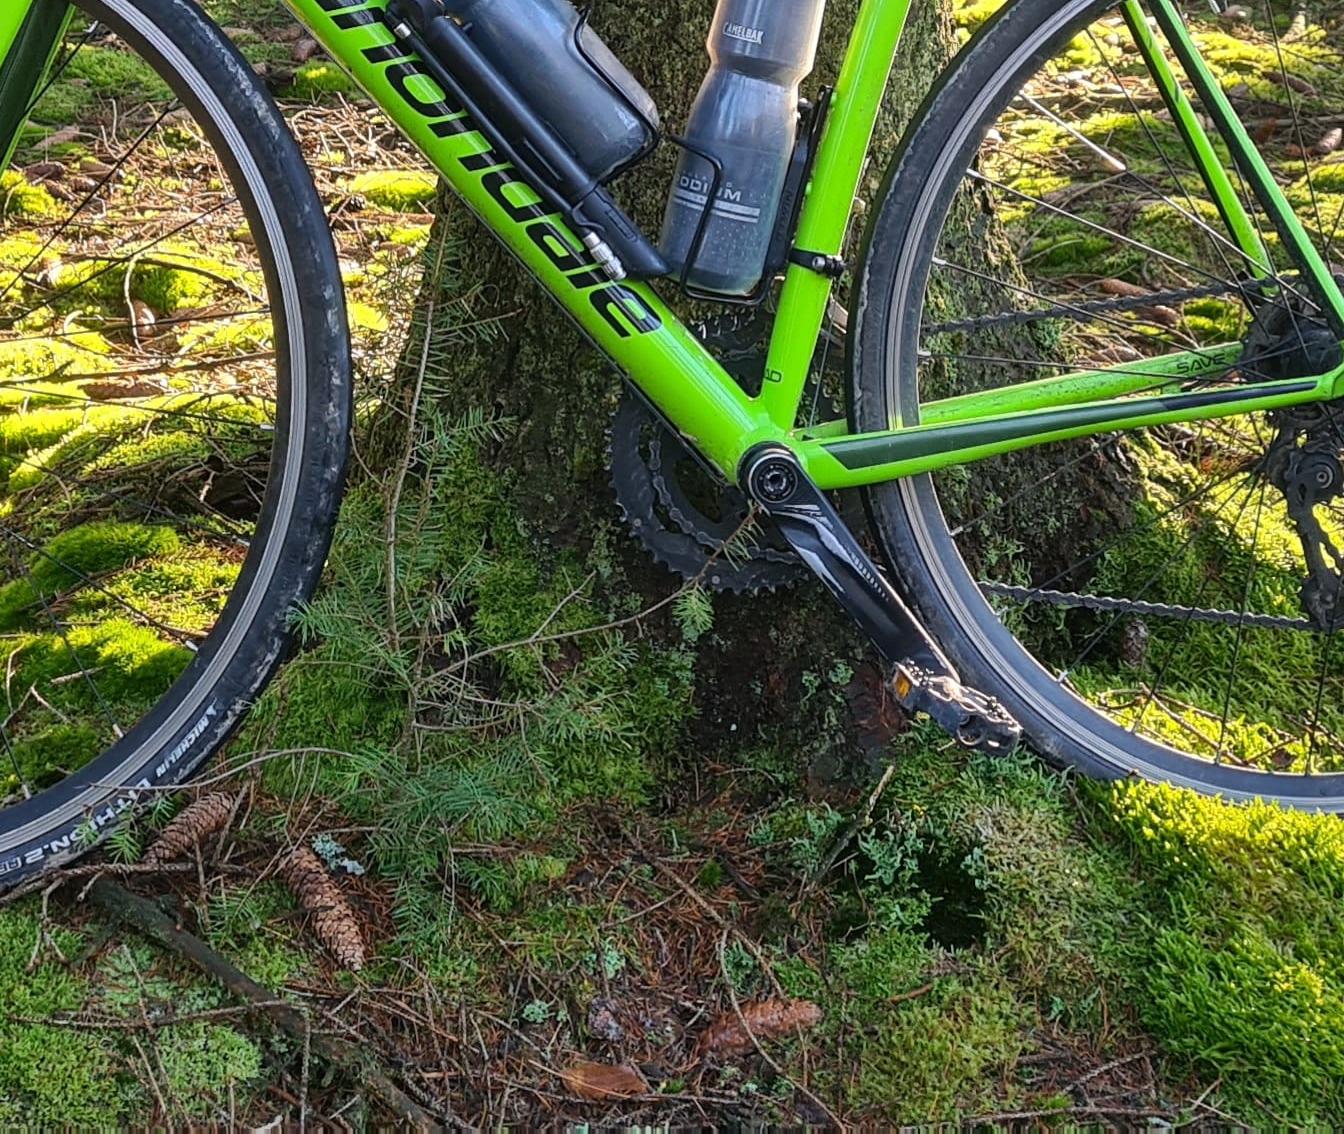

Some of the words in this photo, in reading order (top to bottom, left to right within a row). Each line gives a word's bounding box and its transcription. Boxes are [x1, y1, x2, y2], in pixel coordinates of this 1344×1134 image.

[722, 21, 764, 45] CAMELBAK
[1177, 352, 1226, 374] SAVE
[156, 715, 210, 778] MICHELIN
